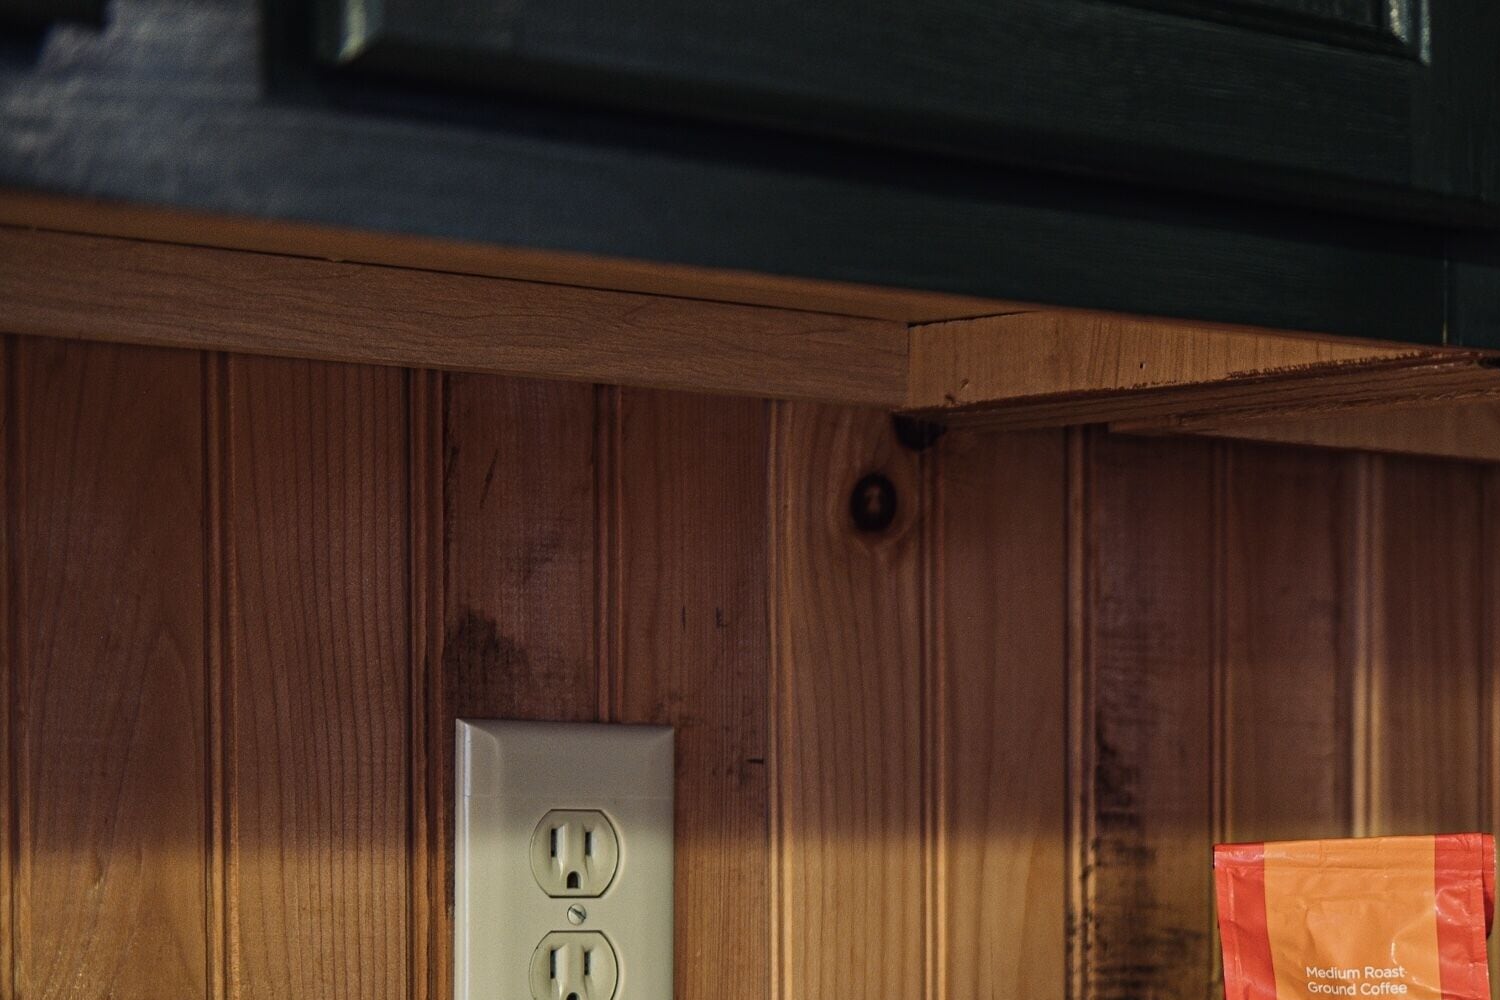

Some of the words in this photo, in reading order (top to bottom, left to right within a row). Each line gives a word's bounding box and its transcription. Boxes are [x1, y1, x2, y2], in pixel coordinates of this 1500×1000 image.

[1306, 966, 1360, 979] Medium
[1364, 966, 1405, 979] Roast
[1307, 981, 1357, 996] Ground
[1360, 982, 1408, 996] Coffee
